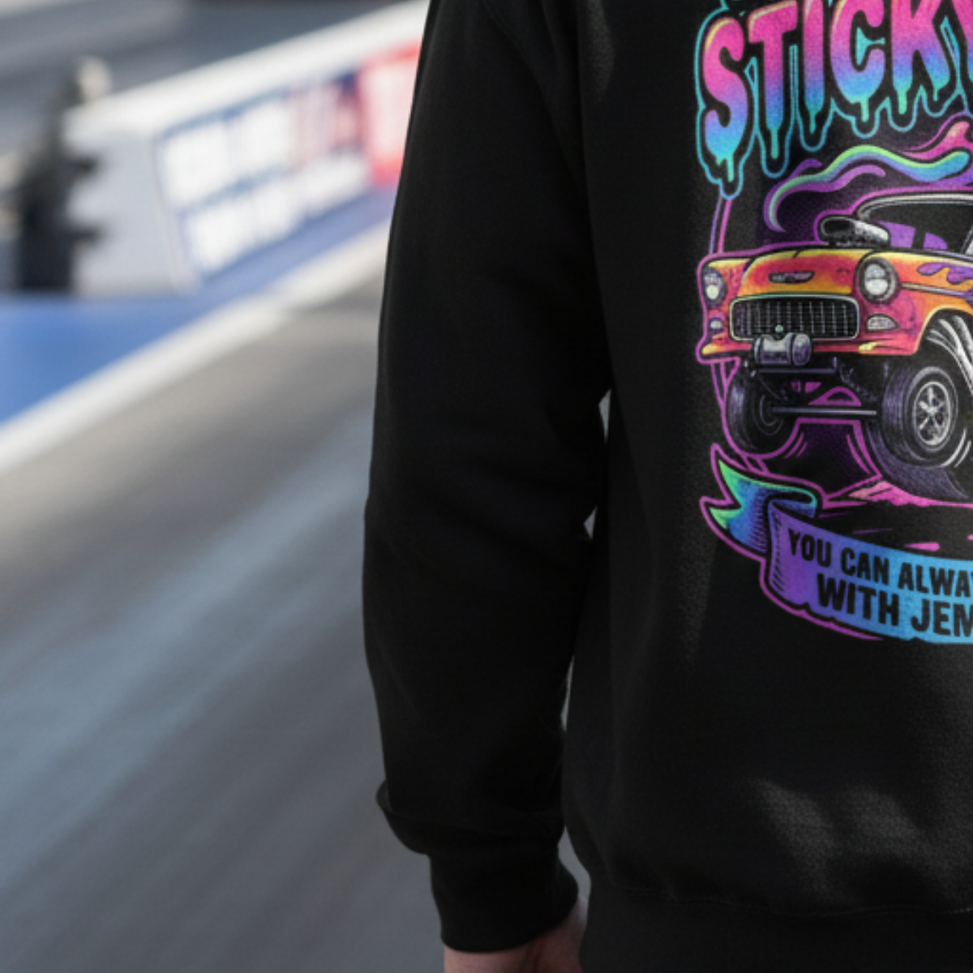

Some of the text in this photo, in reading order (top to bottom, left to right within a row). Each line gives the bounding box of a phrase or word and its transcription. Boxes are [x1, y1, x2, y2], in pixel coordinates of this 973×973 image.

[788, 528, 832, 568] YOU
[840, 547, 889, 585] CAN
[817, 573, 900, 627] WITH
